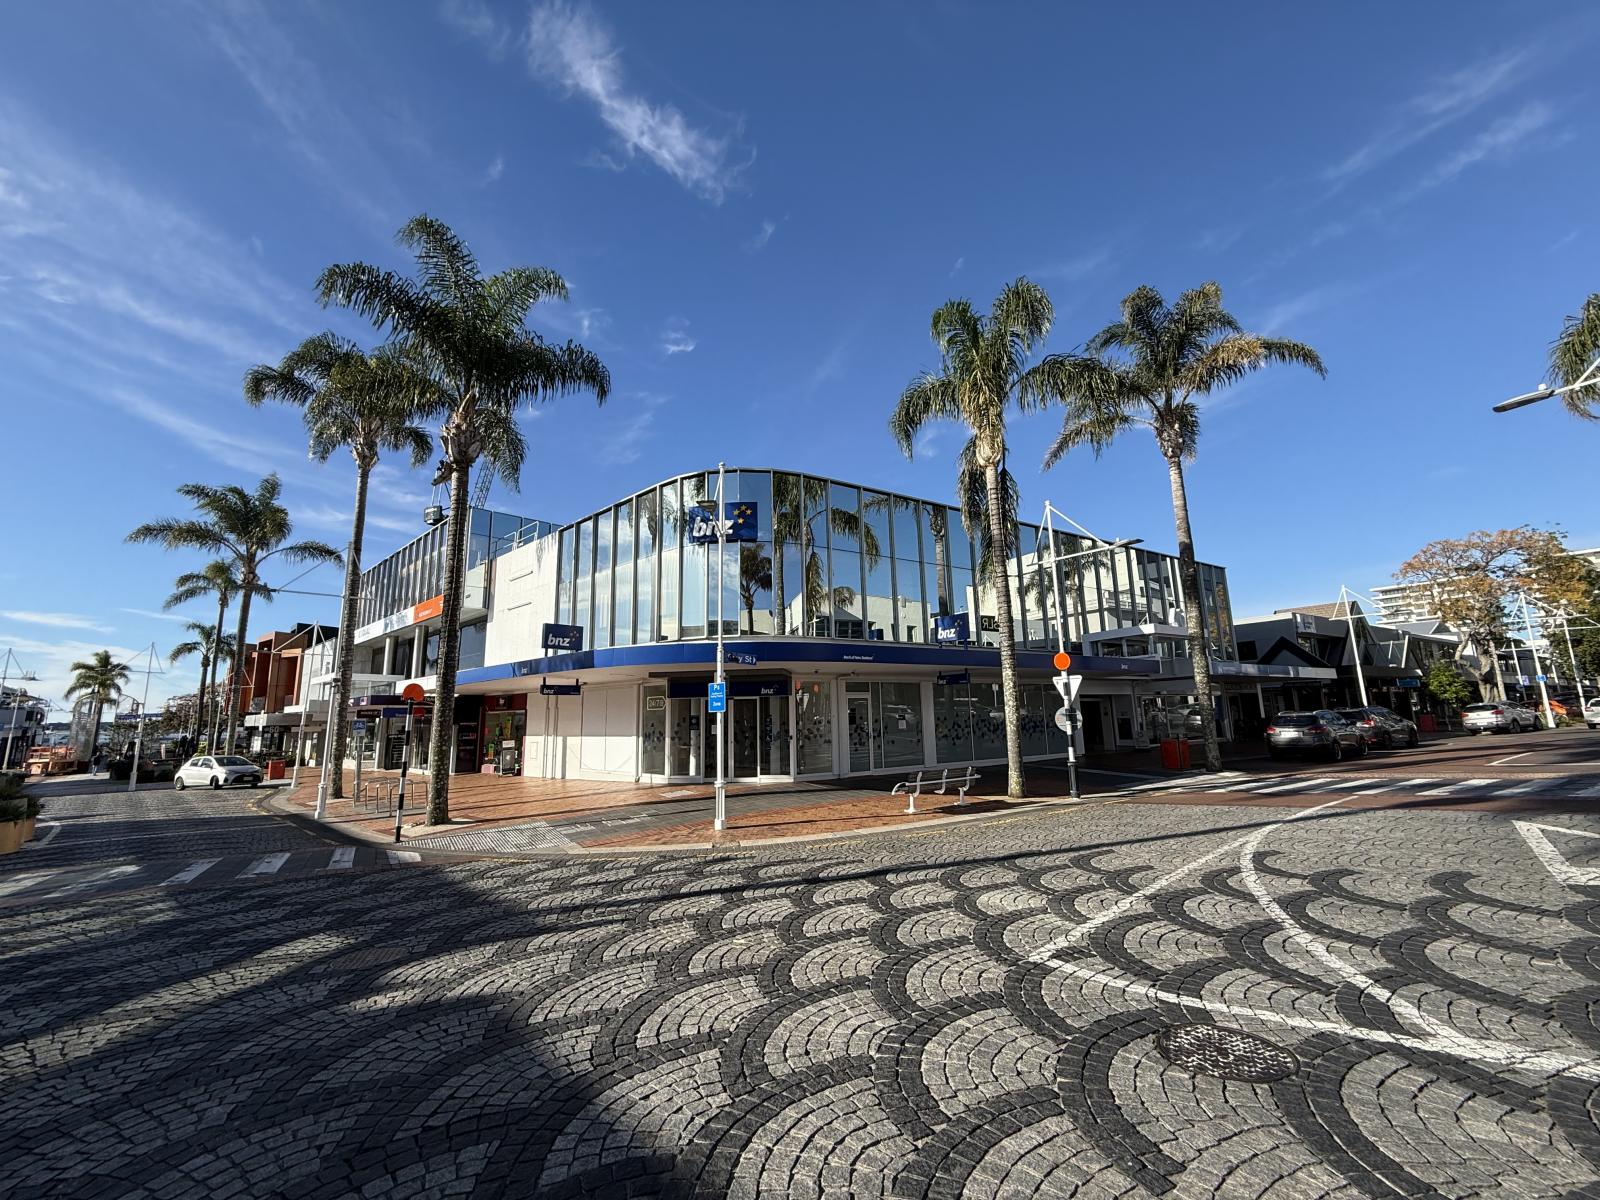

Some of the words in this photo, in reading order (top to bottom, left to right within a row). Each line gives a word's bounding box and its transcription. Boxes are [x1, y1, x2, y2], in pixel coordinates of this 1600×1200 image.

[692, 516, 735, 537] bnz
[547, 633, 571, 647] bnz
[937, 627, 956, 640] bnz
[761, 687, 774, 695] bnz
